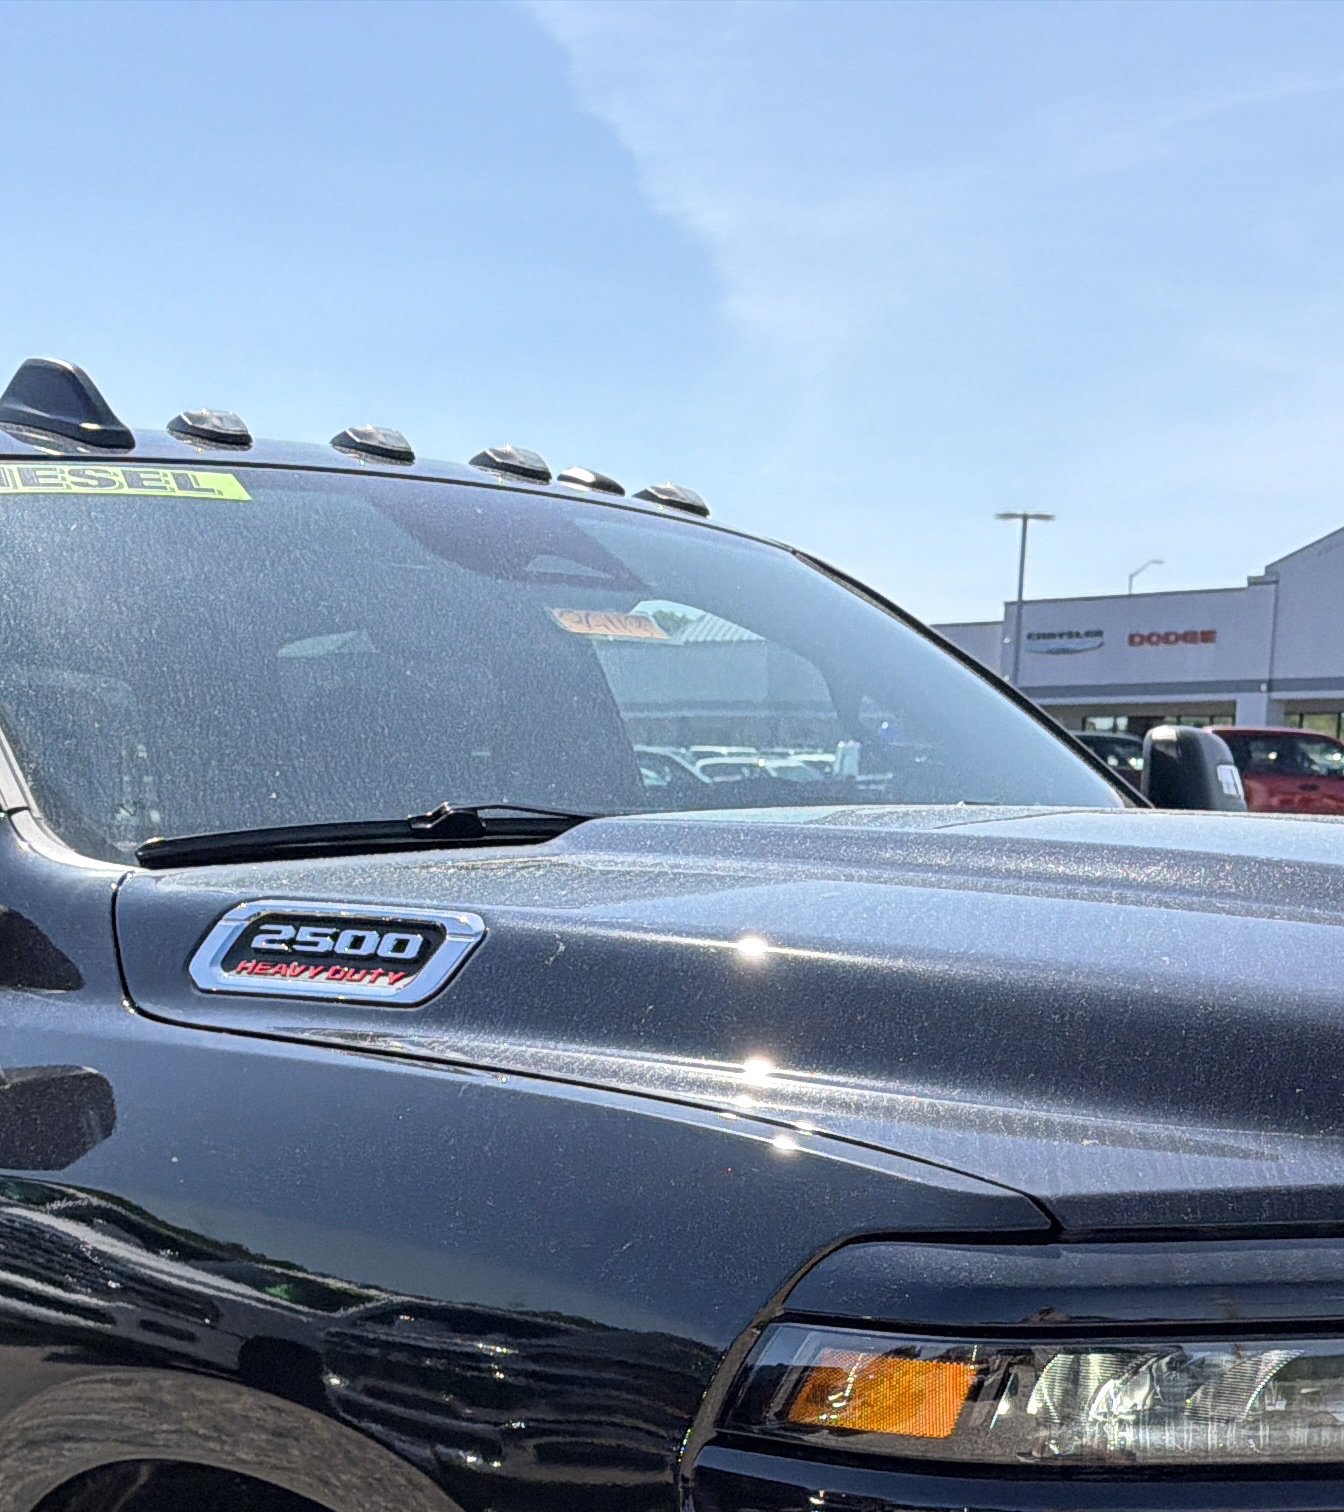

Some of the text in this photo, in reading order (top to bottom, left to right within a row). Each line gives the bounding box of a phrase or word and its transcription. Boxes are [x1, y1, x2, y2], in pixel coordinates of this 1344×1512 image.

[1128, 629, 1217, 647] DODGE
[252, 924, 424, 958] 2500
[236, 960, 406, 985] HEAVY DUTY
